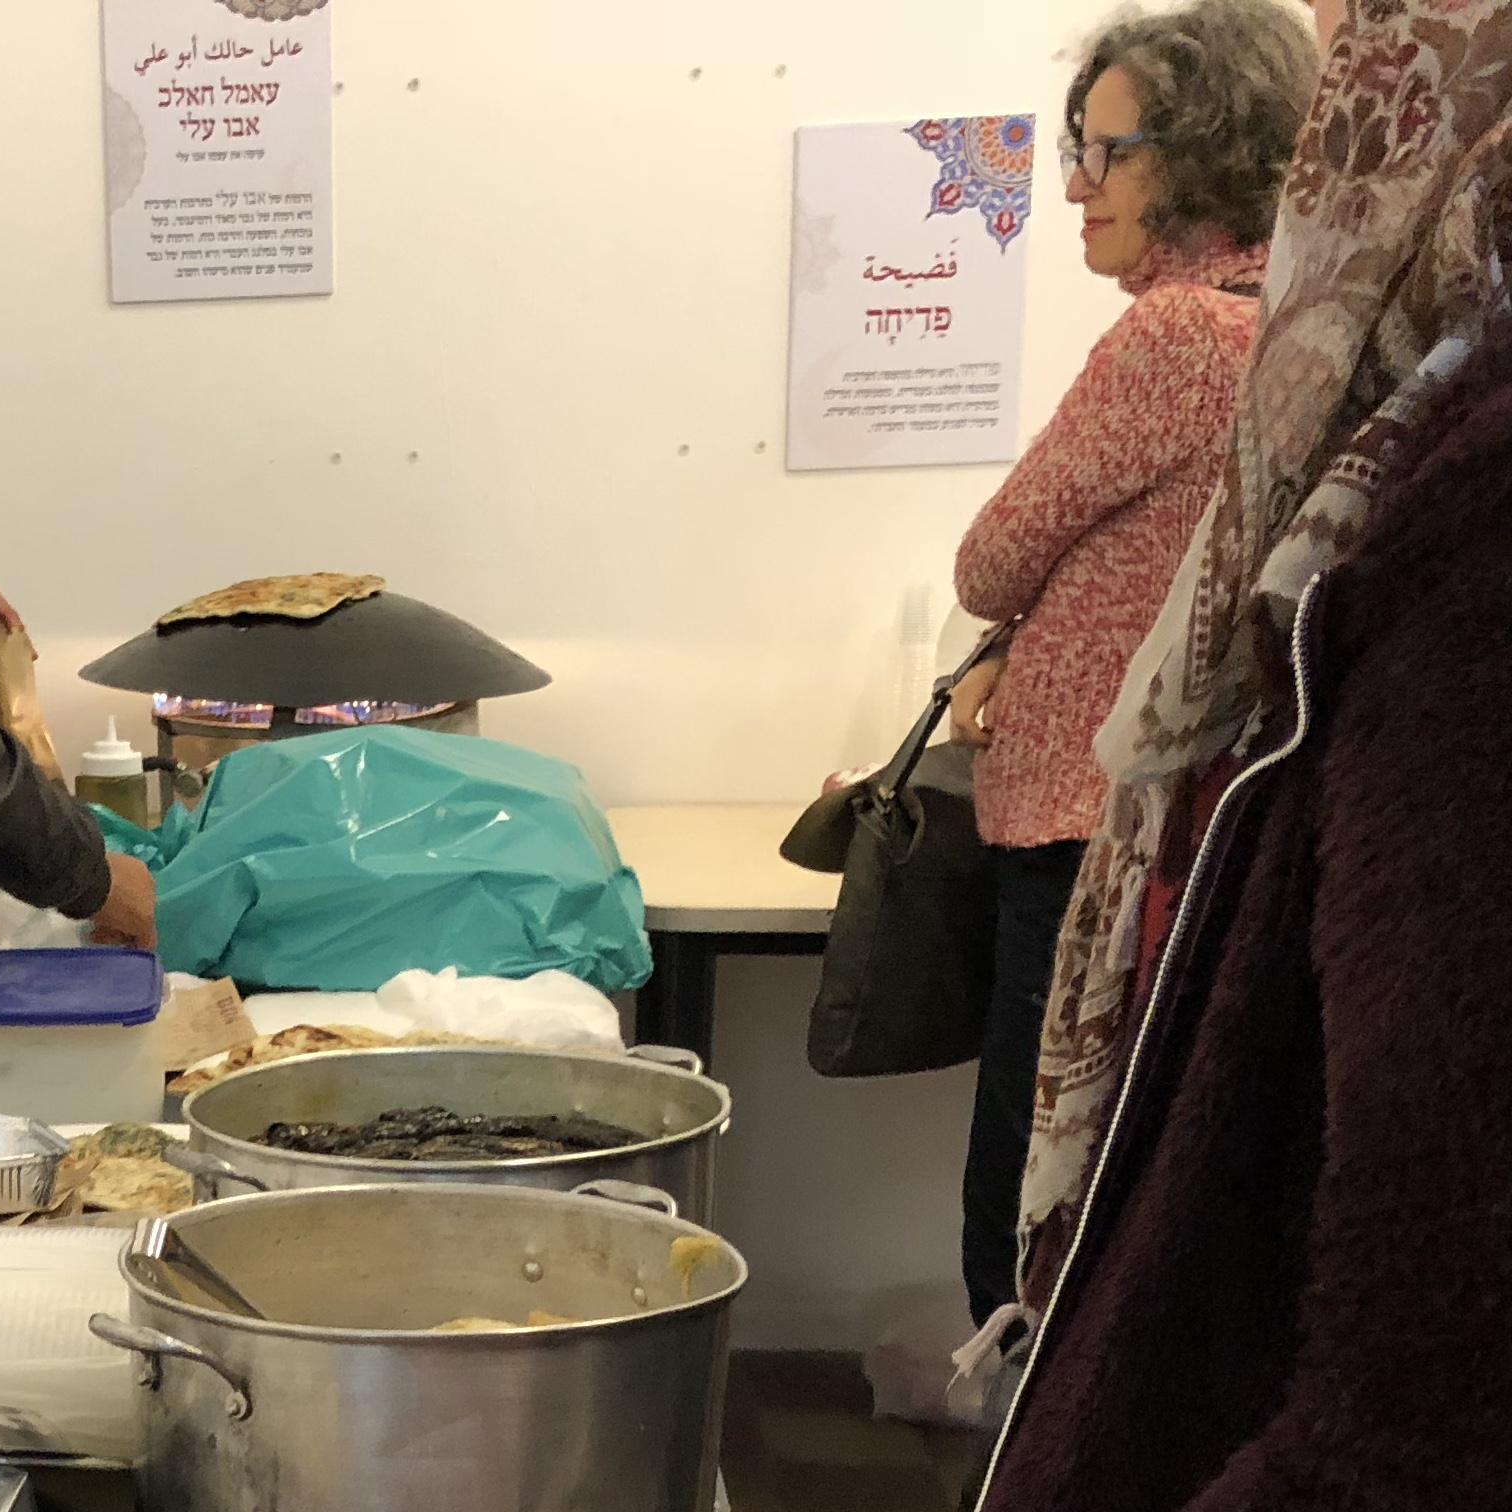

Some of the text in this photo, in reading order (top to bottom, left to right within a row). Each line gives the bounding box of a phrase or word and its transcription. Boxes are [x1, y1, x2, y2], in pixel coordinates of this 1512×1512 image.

[134, 34, 303, 76] عامل حالك أبو علي
[220, 77, 280, 106] עאמל
[179, 112, 260, 141] אבו עלי
[216, 190, 238, 208] עלי
[242, 192, 266, 205] אבו
